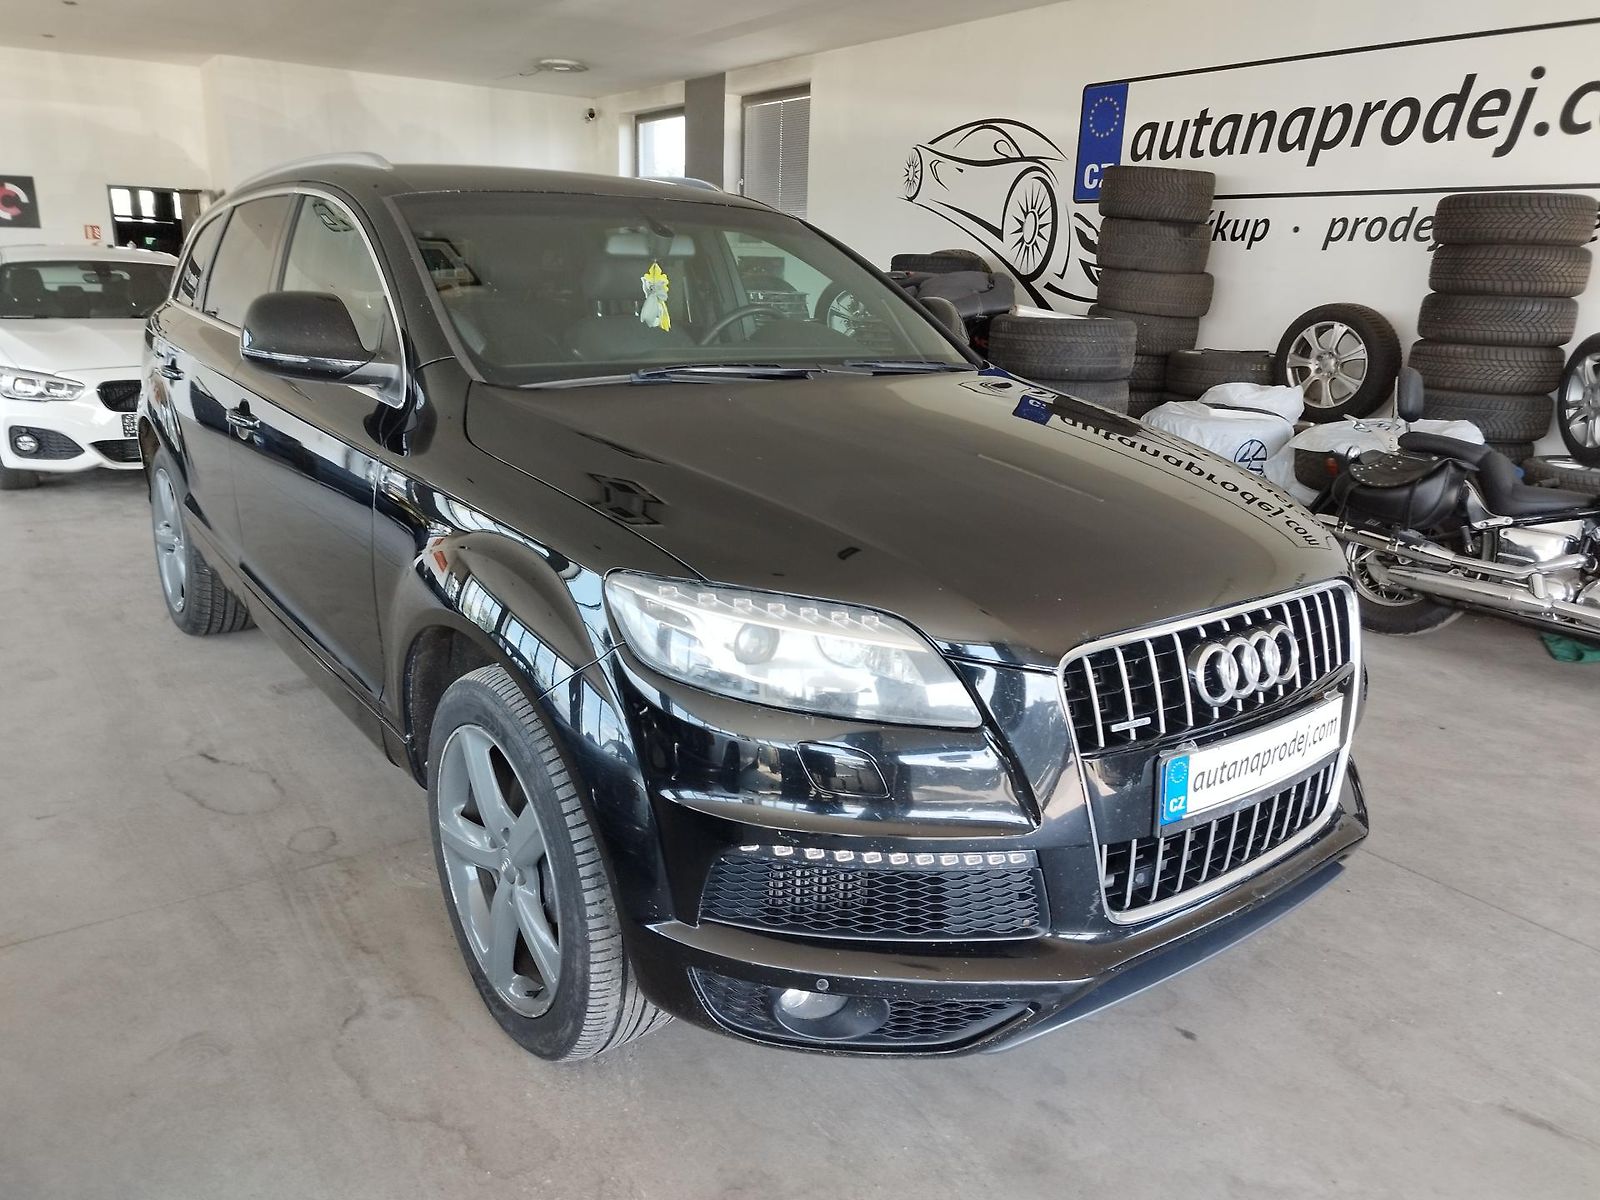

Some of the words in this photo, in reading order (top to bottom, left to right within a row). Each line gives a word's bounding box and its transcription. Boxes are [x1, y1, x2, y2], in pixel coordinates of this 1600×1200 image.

[1130, 65, 1600, 167] autanaprodej.c
[1207, 209, 1271, 250] kup
[1193, 717, 1338, 792] autanaprodej.com
[1169, 795, 1185, 812] CZ
